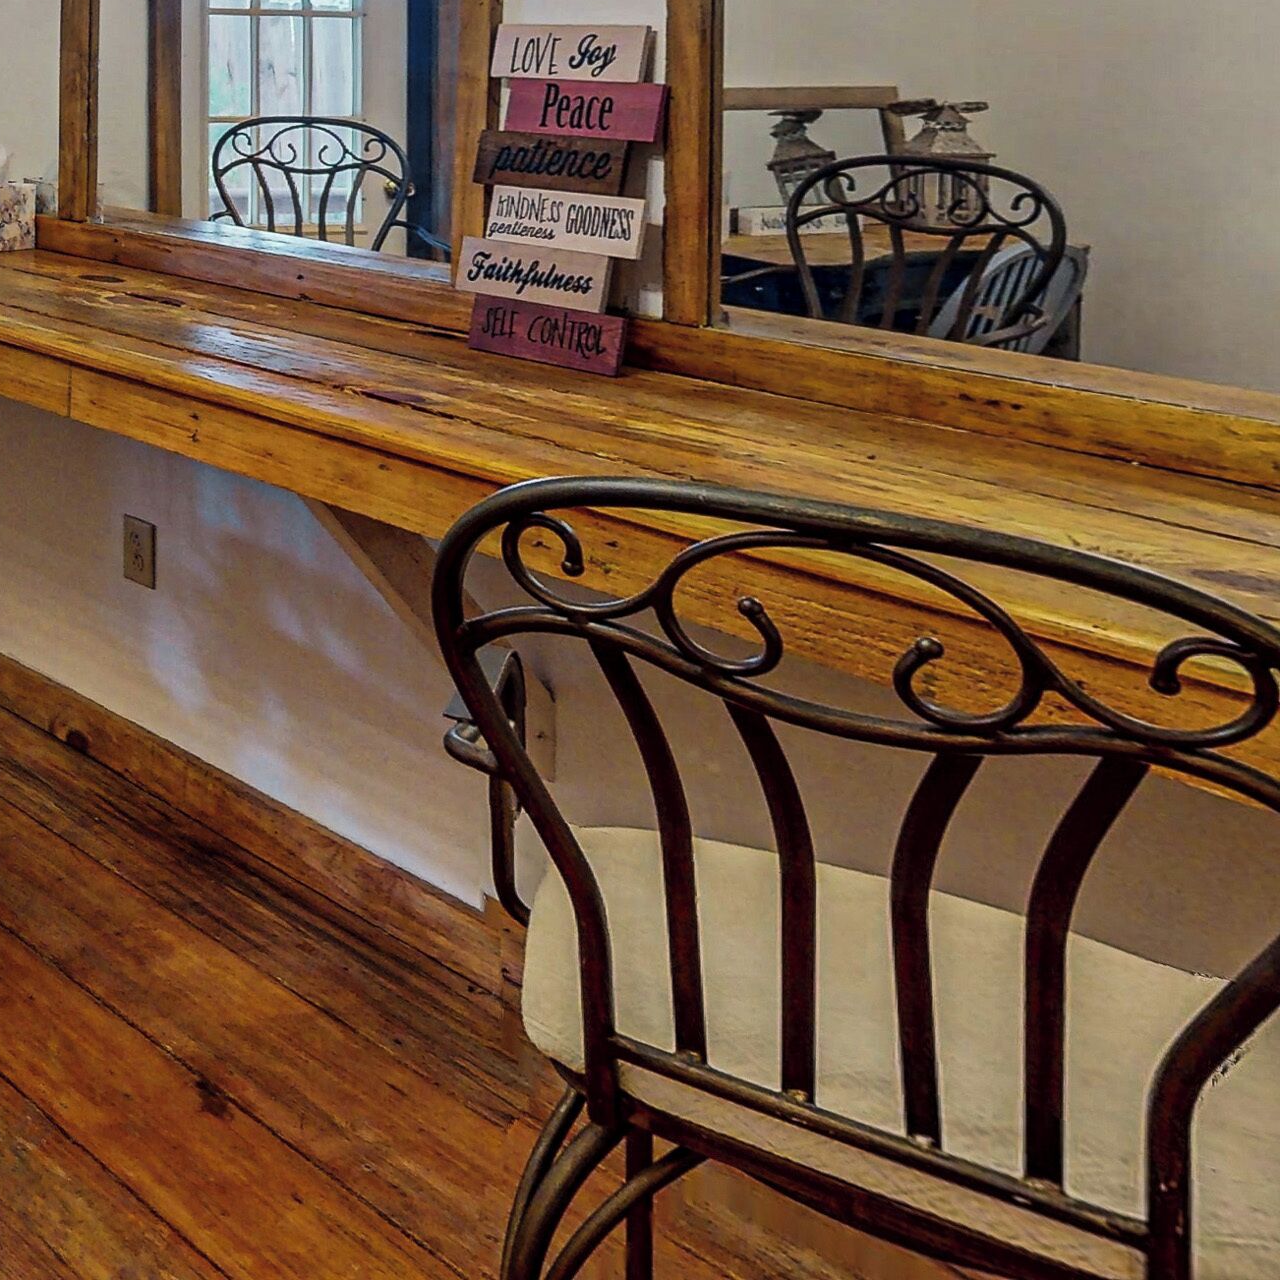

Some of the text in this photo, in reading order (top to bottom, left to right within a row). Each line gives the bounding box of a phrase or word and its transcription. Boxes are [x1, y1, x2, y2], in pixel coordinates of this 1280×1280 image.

[510, 32, 616, 77] LOVE Joy
[539, 82, 614, 132] Peace
[488, 138, 612, 180] patience
[488, 220, 556, 240] gentleness
[496, 190, 634, 241] KINDNESS GOODNESS
[468, 252, 592, 294] Faithfulness
[481, 306, 607, 360] SELF CONTROL
